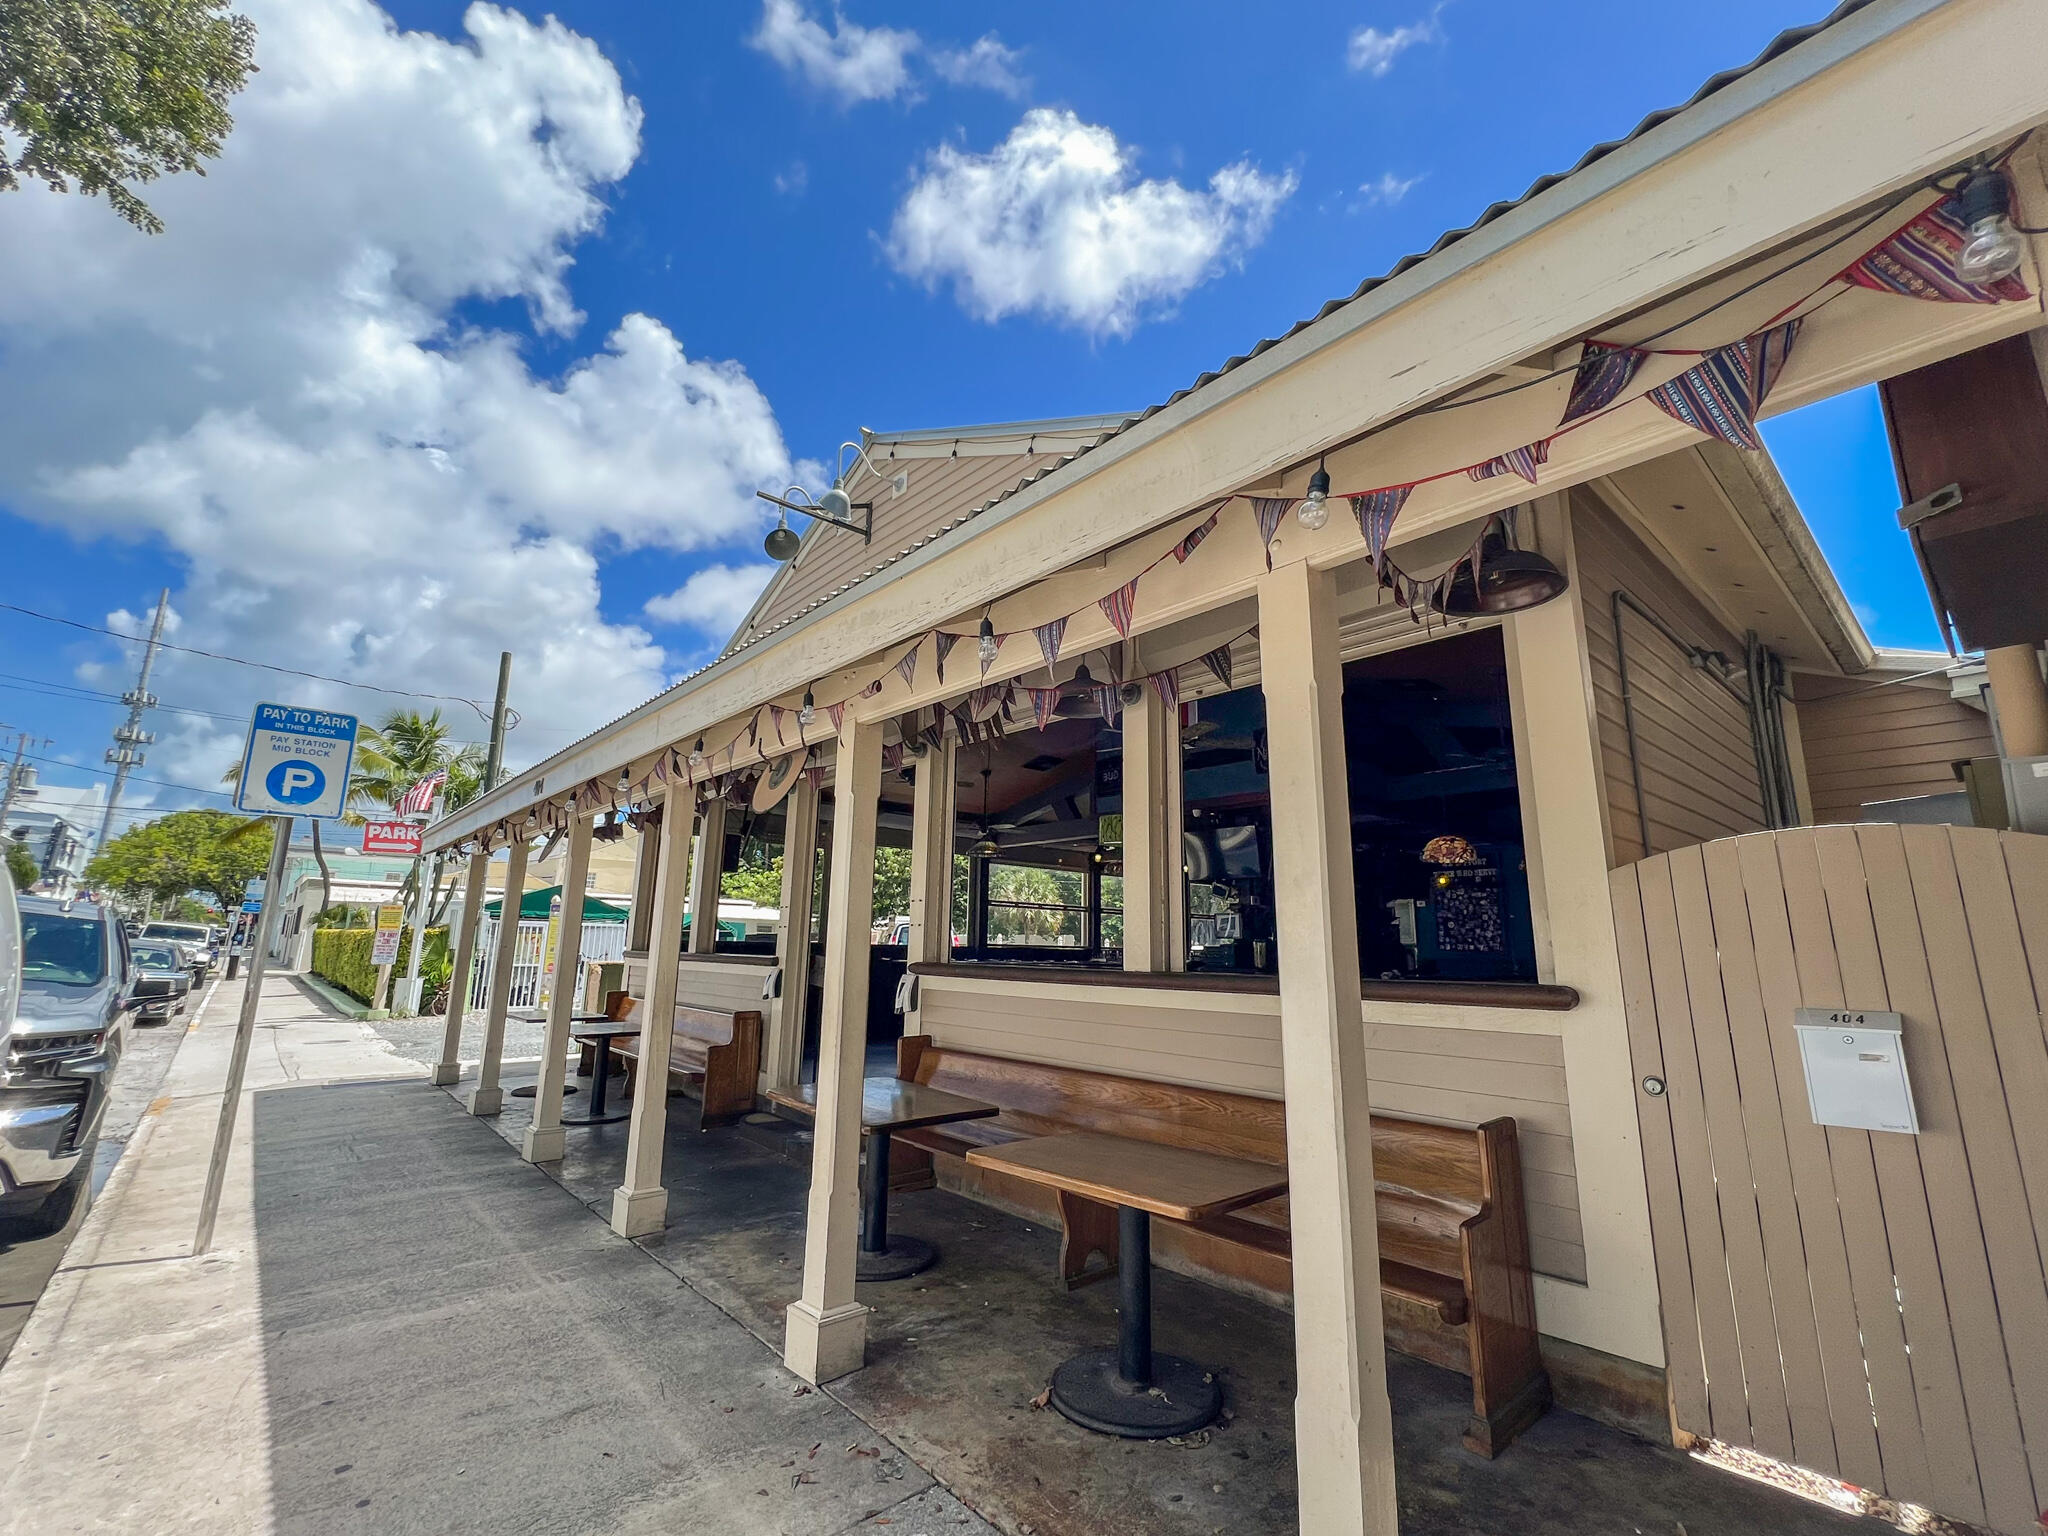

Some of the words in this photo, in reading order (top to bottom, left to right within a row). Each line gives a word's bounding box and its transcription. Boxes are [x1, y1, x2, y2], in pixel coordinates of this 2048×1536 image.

[263, 707, 289, 719] PAY
[293, 711, 311, 724] TO
[315, 714, 351, 729] PARK
[287, 723, 305, 732] THIS
[307, 727, 336, 736] BLOCK
[270, 735, 290, 744] PAY
[294, 738, 336, 749] STATION
[272, 744, 292, 753] MID
[295, 748, 331, 758] BLOCK
[281, 767, 316, 797] P
[368, 825, 420, 840] PARK
[1830, 1013, 1864, 1024] 404
